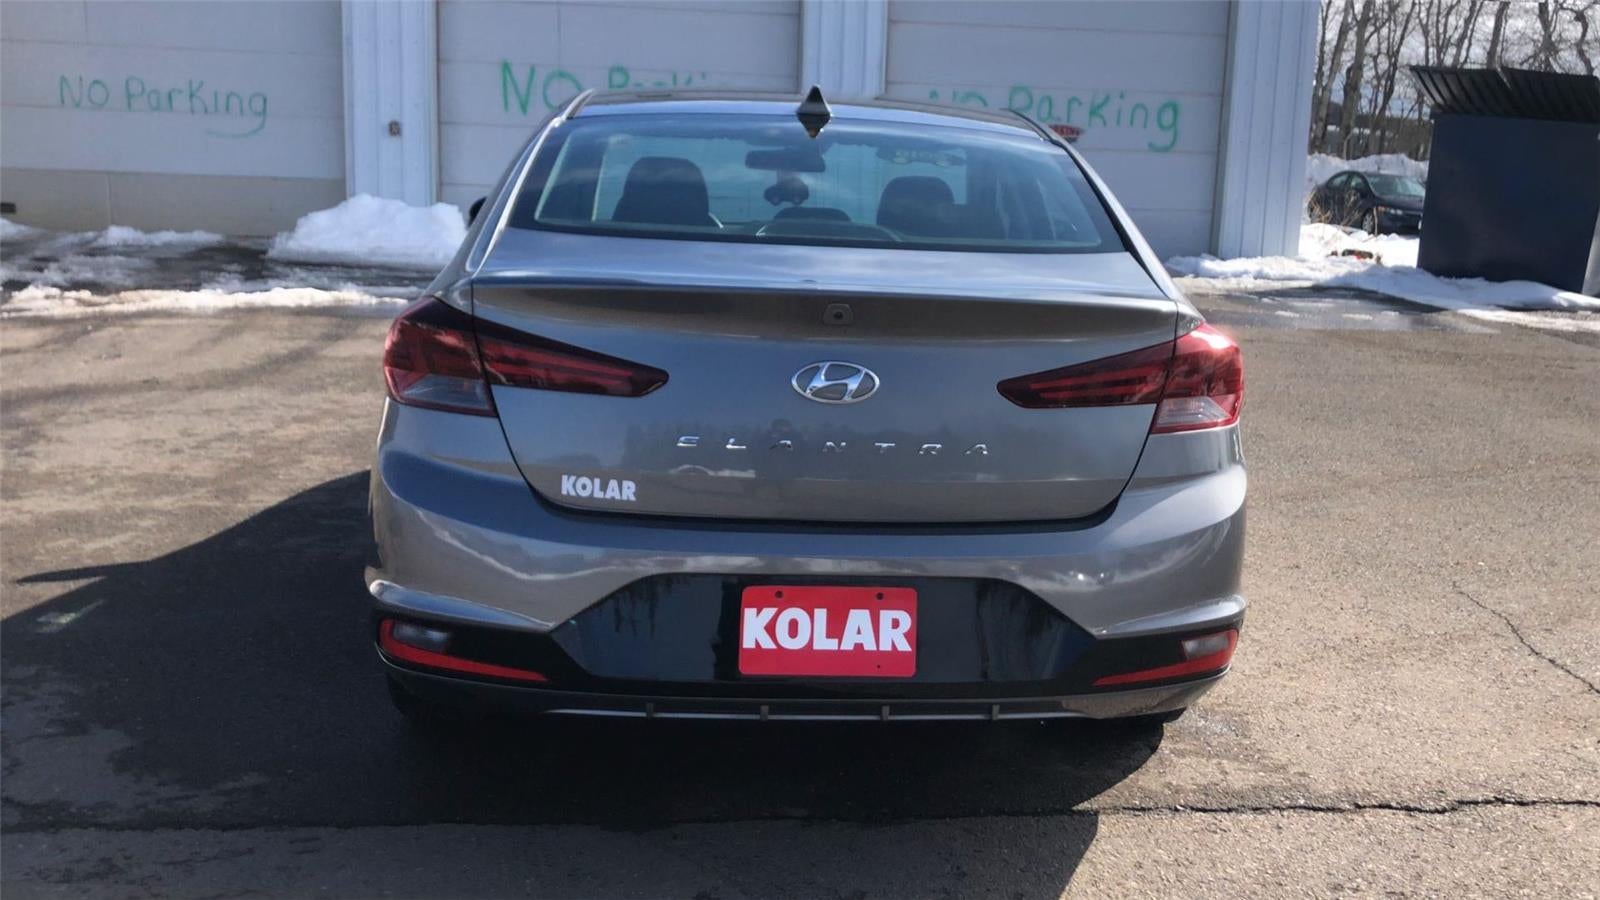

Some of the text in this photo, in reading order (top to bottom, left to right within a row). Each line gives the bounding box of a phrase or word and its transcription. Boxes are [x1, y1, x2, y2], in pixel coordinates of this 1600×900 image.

[59, 74, 110, 109] NO
[676, 435, 989, 455] ELANTRA
[561, 474, 637, 502] KOLAR
[742, 606, 913, 652] KOLAR
